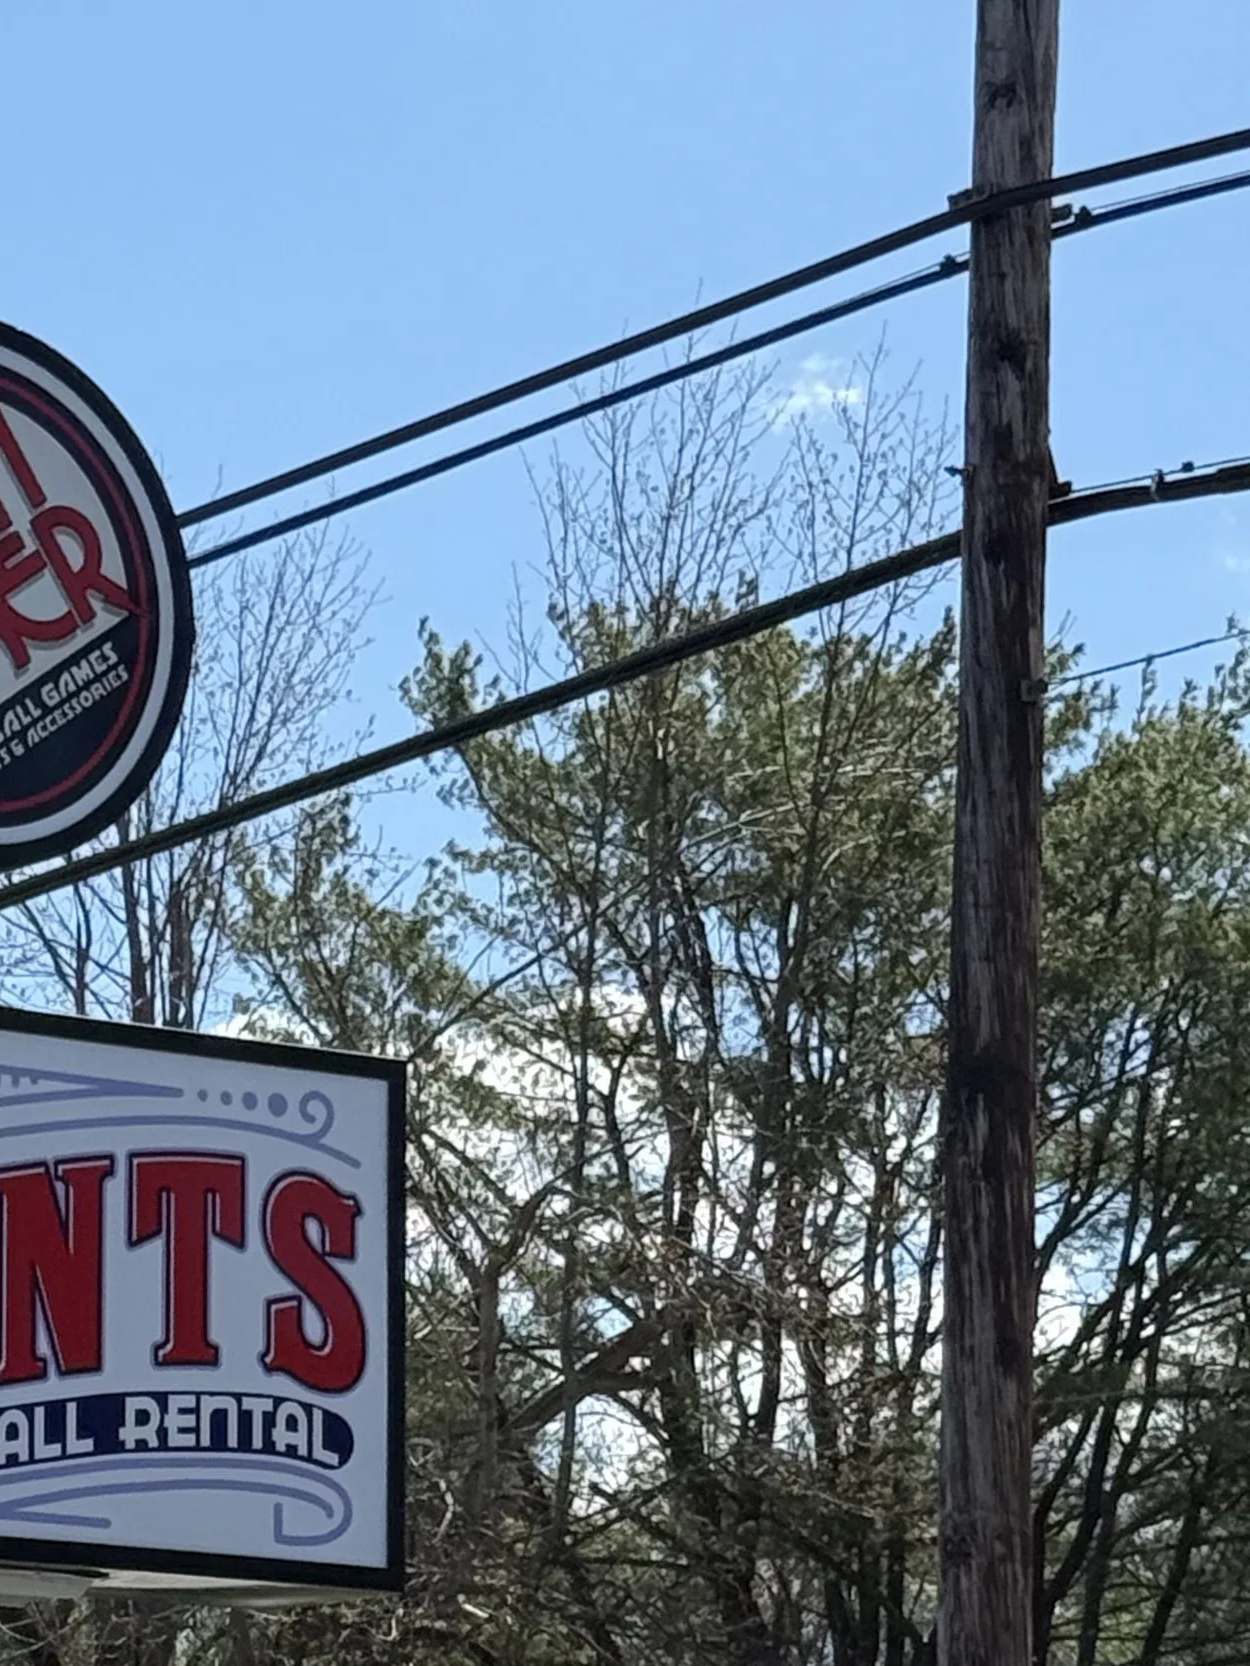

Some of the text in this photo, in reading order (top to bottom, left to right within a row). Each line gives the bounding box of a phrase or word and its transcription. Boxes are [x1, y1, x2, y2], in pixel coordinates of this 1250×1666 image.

[10, 739, 25, 756] &
[26, 664, 129, 748] ACCESSORIES
[40, 641, 118, 708] GAMES
[119, 1396, 341, 1469] RENTAL
